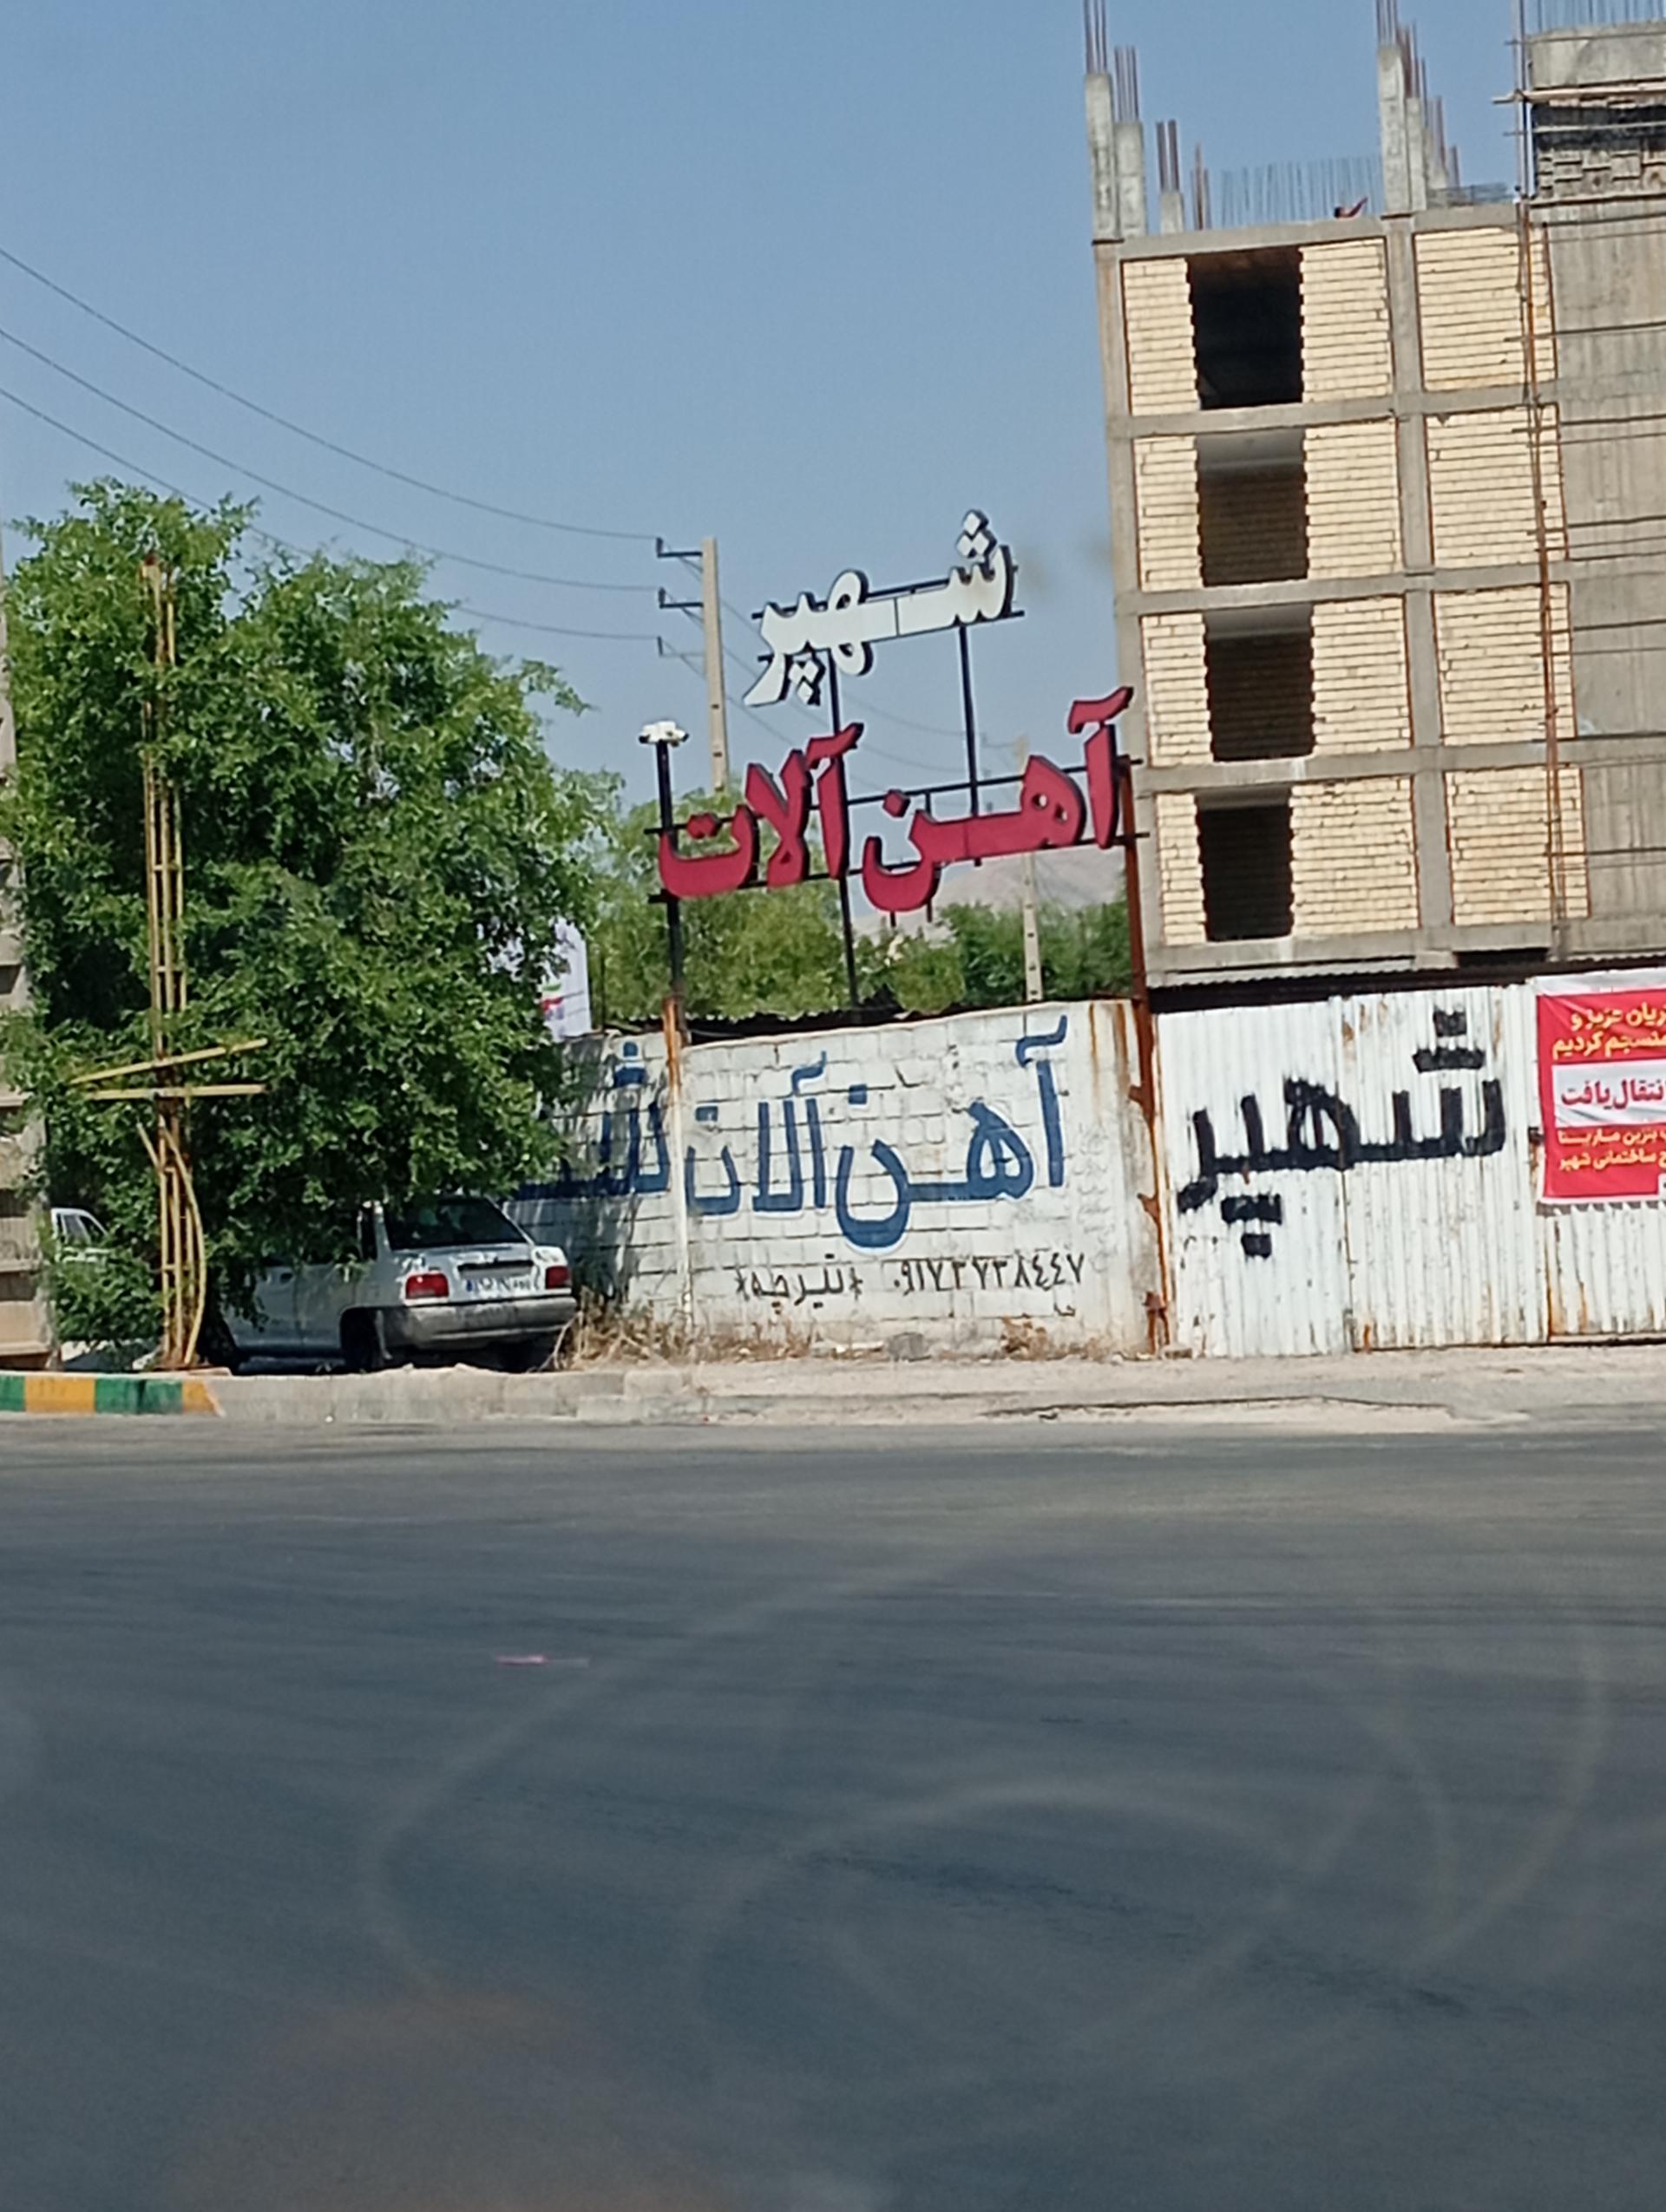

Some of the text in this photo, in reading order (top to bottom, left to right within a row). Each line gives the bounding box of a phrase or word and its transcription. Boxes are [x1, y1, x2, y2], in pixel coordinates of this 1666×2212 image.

[744, 510, 1013, 706] شهپر
[659, 686, 1133, 912] آهن آلات
[685, 1051, 827, 1214] آلات
[836, 1015, 1068, 1248] آهن
[1177, 1009, 1505, 1259] شهپر
[1552, 1031, 1604, 1060] کردیم
[1561, 1078, 1666, 1109] نتقال یافت
